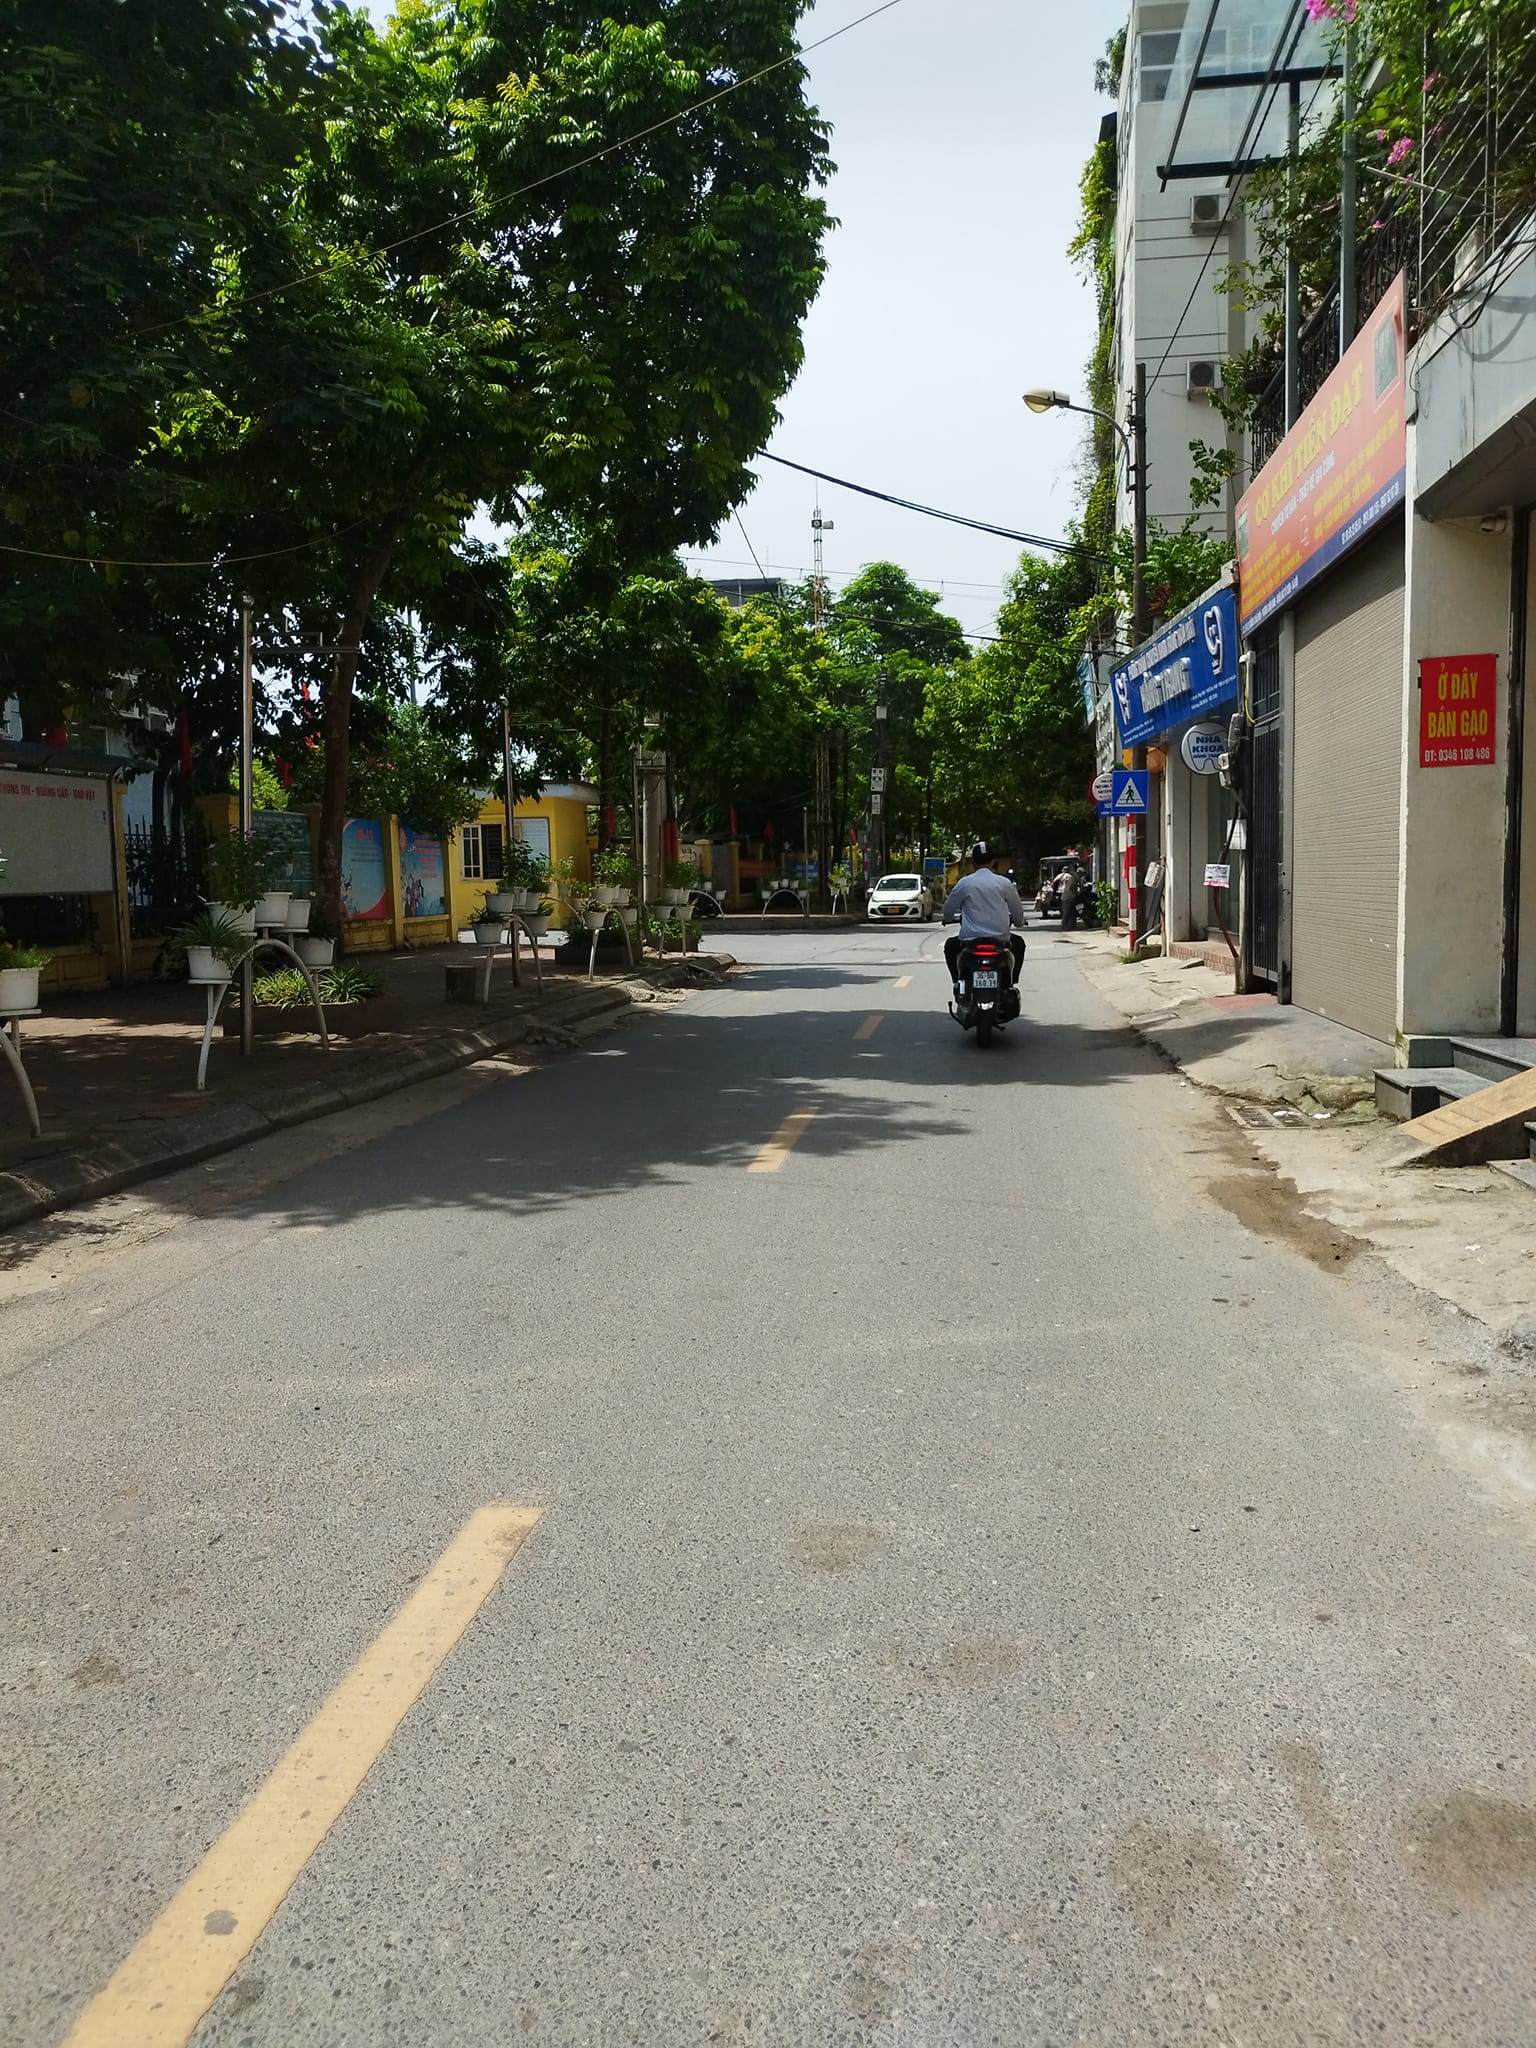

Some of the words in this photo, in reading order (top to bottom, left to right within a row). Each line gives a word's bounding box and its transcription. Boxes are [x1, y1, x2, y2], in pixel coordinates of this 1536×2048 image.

[1330, 361, 1364, 437] ĐẠT
[1438, 662, 1448, 700] Ở
[1451, 667, 1478, 699] ĐÂY
[1428, 705, 1456, 738] BÁN
[1461, 709, 1488, 742] GẠO
[1192, 745, 1224, 753] KHOA
[1439, 748, 1457, 761] 0346
[1460, 747, 1474, 760] 108
